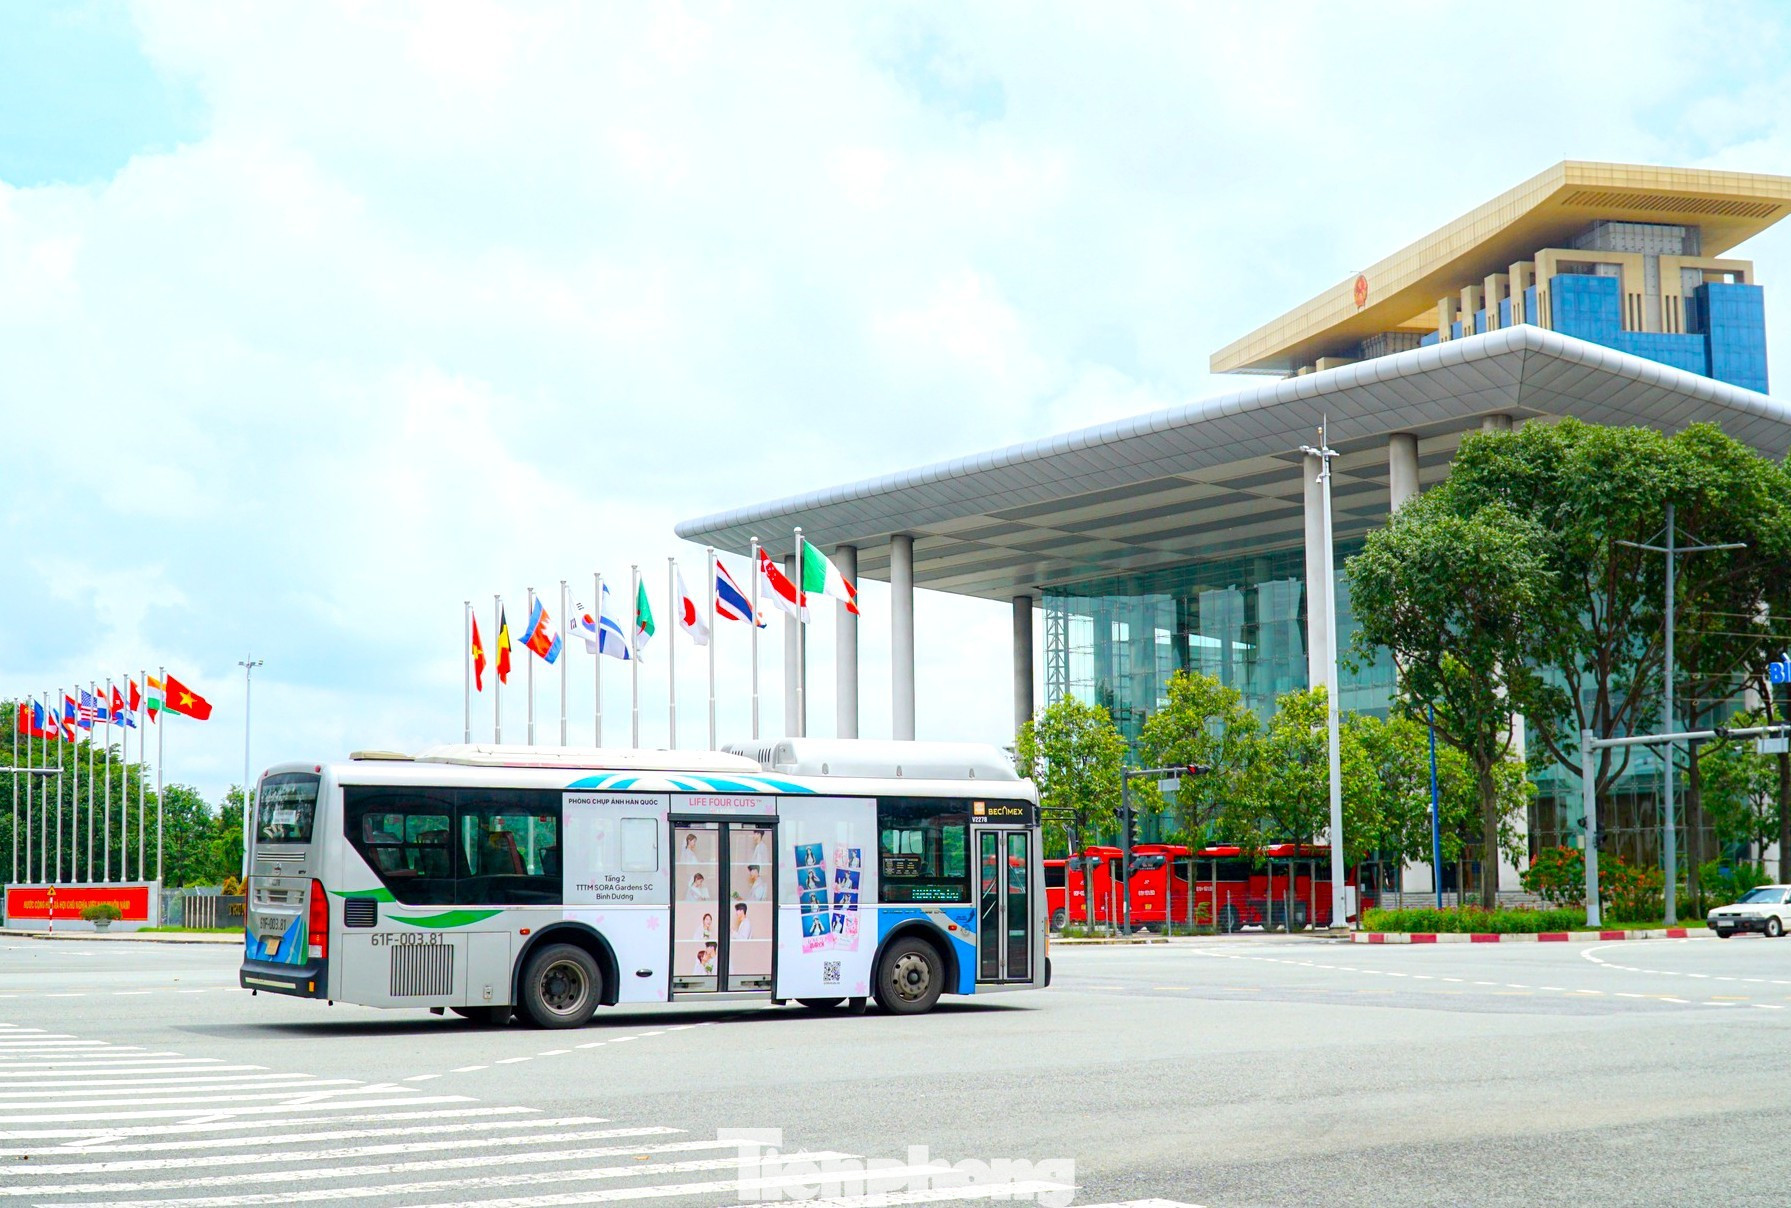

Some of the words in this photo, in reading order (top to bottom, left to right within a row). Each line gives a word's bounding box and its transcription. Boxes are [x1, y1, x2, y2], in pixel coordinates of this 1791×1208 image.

[689, 797, 707, 807] LIFE
[708, 798, 732, 807] FOUR
[614, 883, 643, 891] Gardens
[643, 883, 654, 891] SC
[371, 932, 443, 946] 61F-003.81
